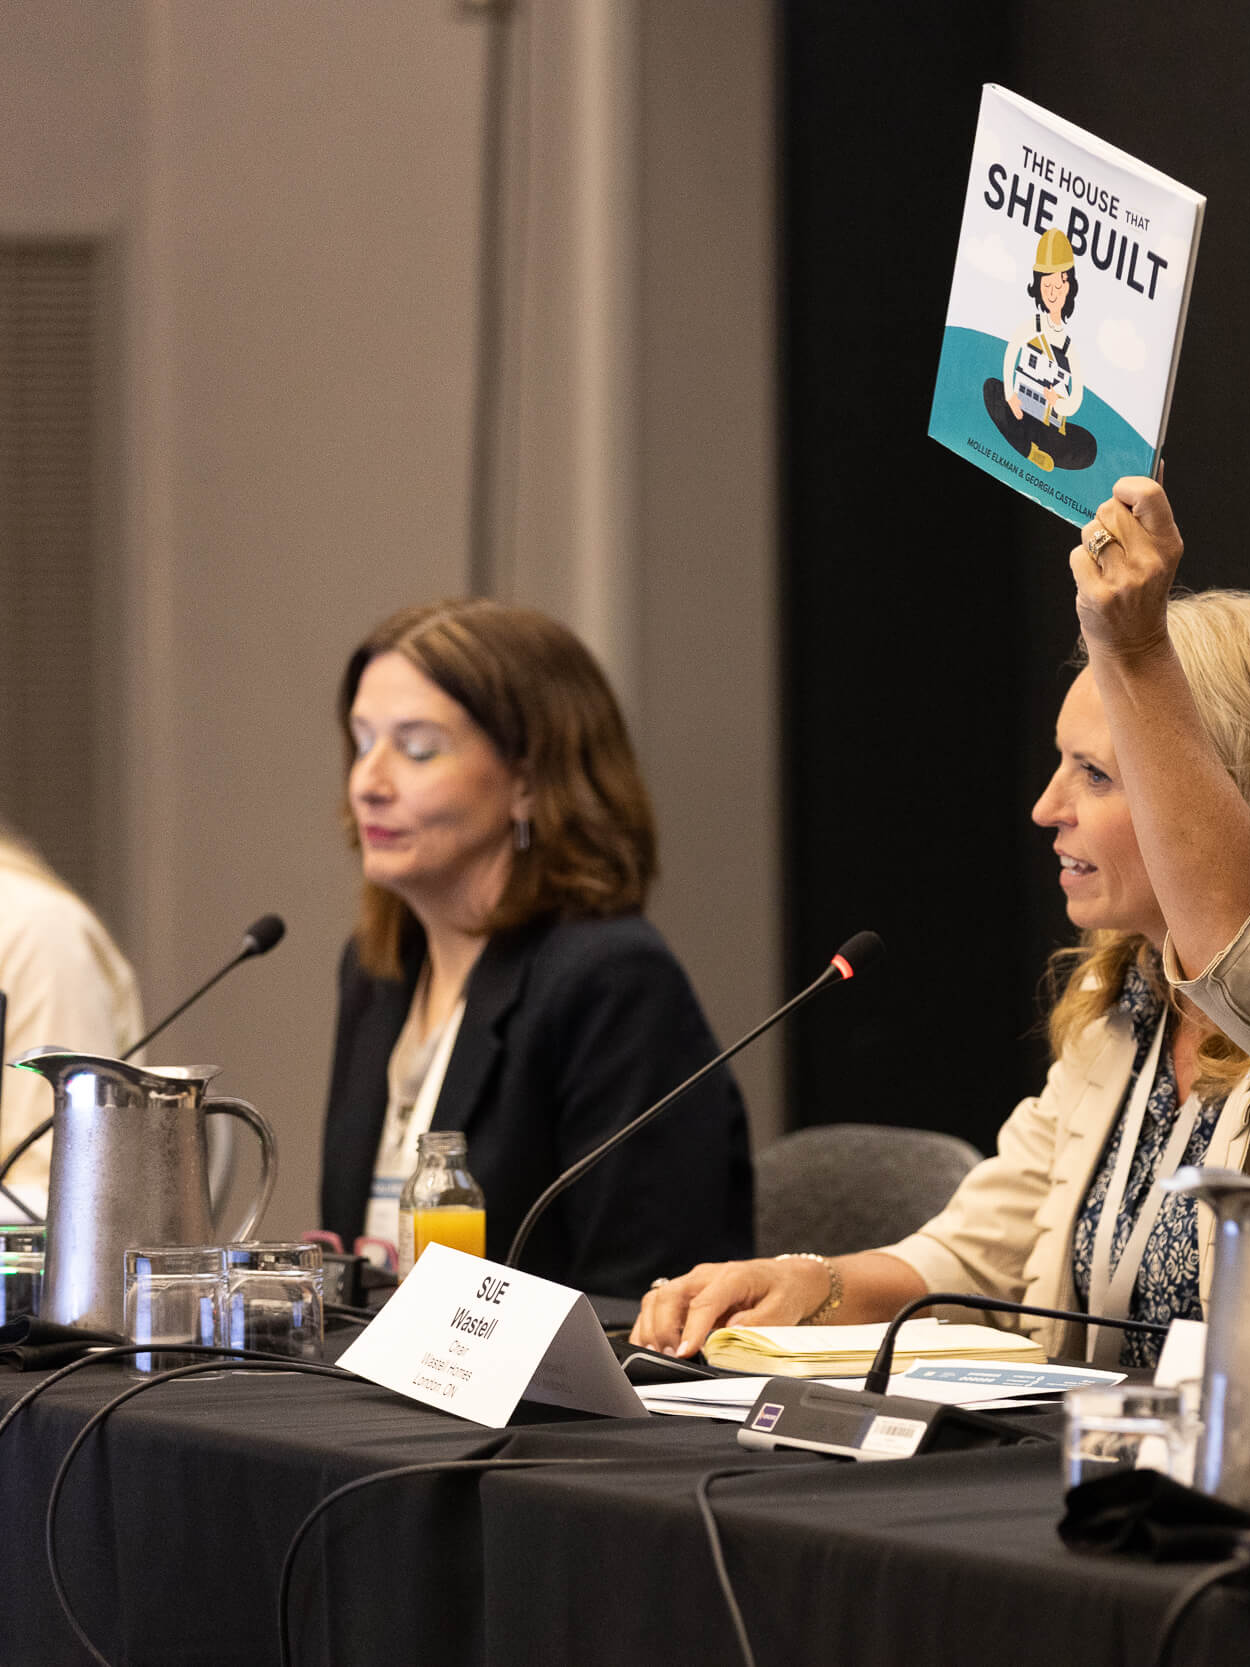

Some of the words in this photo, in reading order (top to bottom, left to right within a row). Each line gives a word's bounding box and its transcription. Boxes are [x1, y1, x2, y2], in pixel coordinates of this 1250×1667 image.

[1022, 145, 1055, 183] THE
[1059, 167, 1120, 219] HOUSE
[1125, 210, 1150, 231] THAT
[984, 163, 1058, 236] SHE
[1066, 207, 1168, 300] BUILT
[967, 437, 991, 458] MOLLIE
[992, 452, 1019, 474] ELKMAN
[1025, 472, 1054, 497] GEORGIA
[476, 1276, 510, 1305] SUE
[450, 1307, 499, 1340] Wastell
